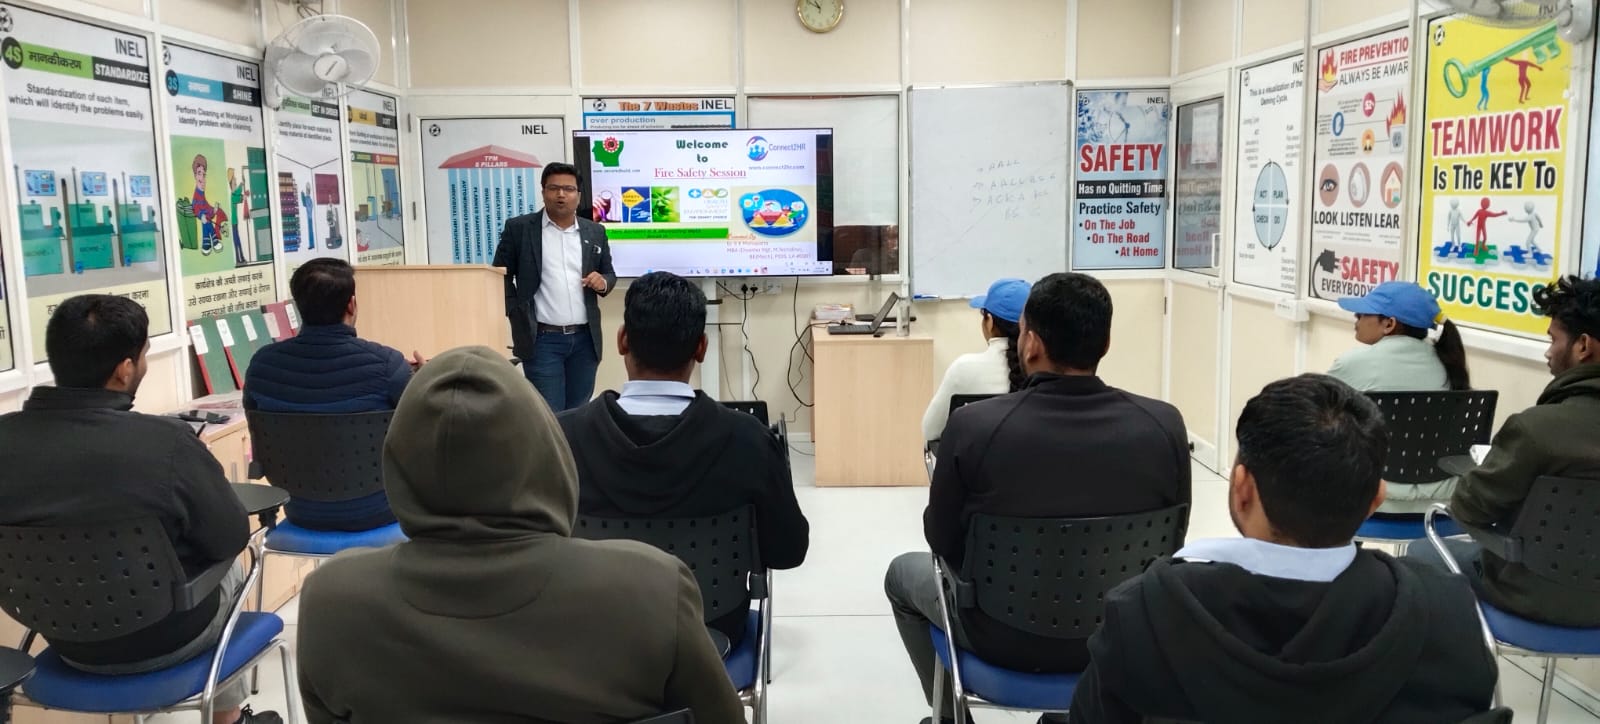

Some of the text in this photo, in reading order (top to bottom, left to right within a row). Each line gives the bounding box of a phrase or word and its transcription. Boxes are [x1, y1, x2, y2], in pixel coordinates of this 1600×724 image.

[6, 48, 21, 62] 4S
[115, 38, 142, 58] INEL
[1340, 37, 1408, 65] FIRE PREVENTIO
[29, 50, 82, 70] मानकीकरण
[1292, 60, 1304, 74] INE
[95, 64, 148, 83] STANDARDIZE
[237, 64, 256, 82] INEL
[1339, 61, 1408, 86] ALWAYS BE AWAR
[167, 76, 178, 90] 3S
[27, 84, 86, 100] Standardization
[88, 91, 95, 101] of
[97, 95, 112, 104] each
[233, 89, 253, 101] SHINE
[1147, 96, 1166, 104] INEL
[8, 96, 34, 106] which
[36, 97, 49, 108] will
[52, 100, 78, 113] identify
[81, 102, 92, 113] the
[94, 105, 124, 118] problems
[176, 105, 197, 114] Perform
[198, 106, 219, 119] Cleaning
[618, 102, 698, 111] The 7 Wastes
[701, 100, 732, 110] INEL
[522, 125, 548, 135] INEL
[1432, 108, 1562, 156] TEAMWORK
[676, 139, 728, 149] Welcome
[697, 154, 708, 163] to
[1080, 144, 1162, 172] SAFETY
[655, 167, 746, 178] Fire Safety Session
[1434, 161, 1556, 190] Is The KEY To
[1079, 182, 1163, 195] Has no Quitting Time
[1273, 190, 1283, 198] PLAN
[1079, 202, 1160, 215] Practice Safety
[1084, 219, 1135, 230] On The Job
[1314, 211, 1400, 229] LOOK LISTEN LEAR
[1092, 233, 1150, 243] On The Road
[1120, 246, 1158, 256] At Home
[1341, 256, 1399, 284] SAFETY
